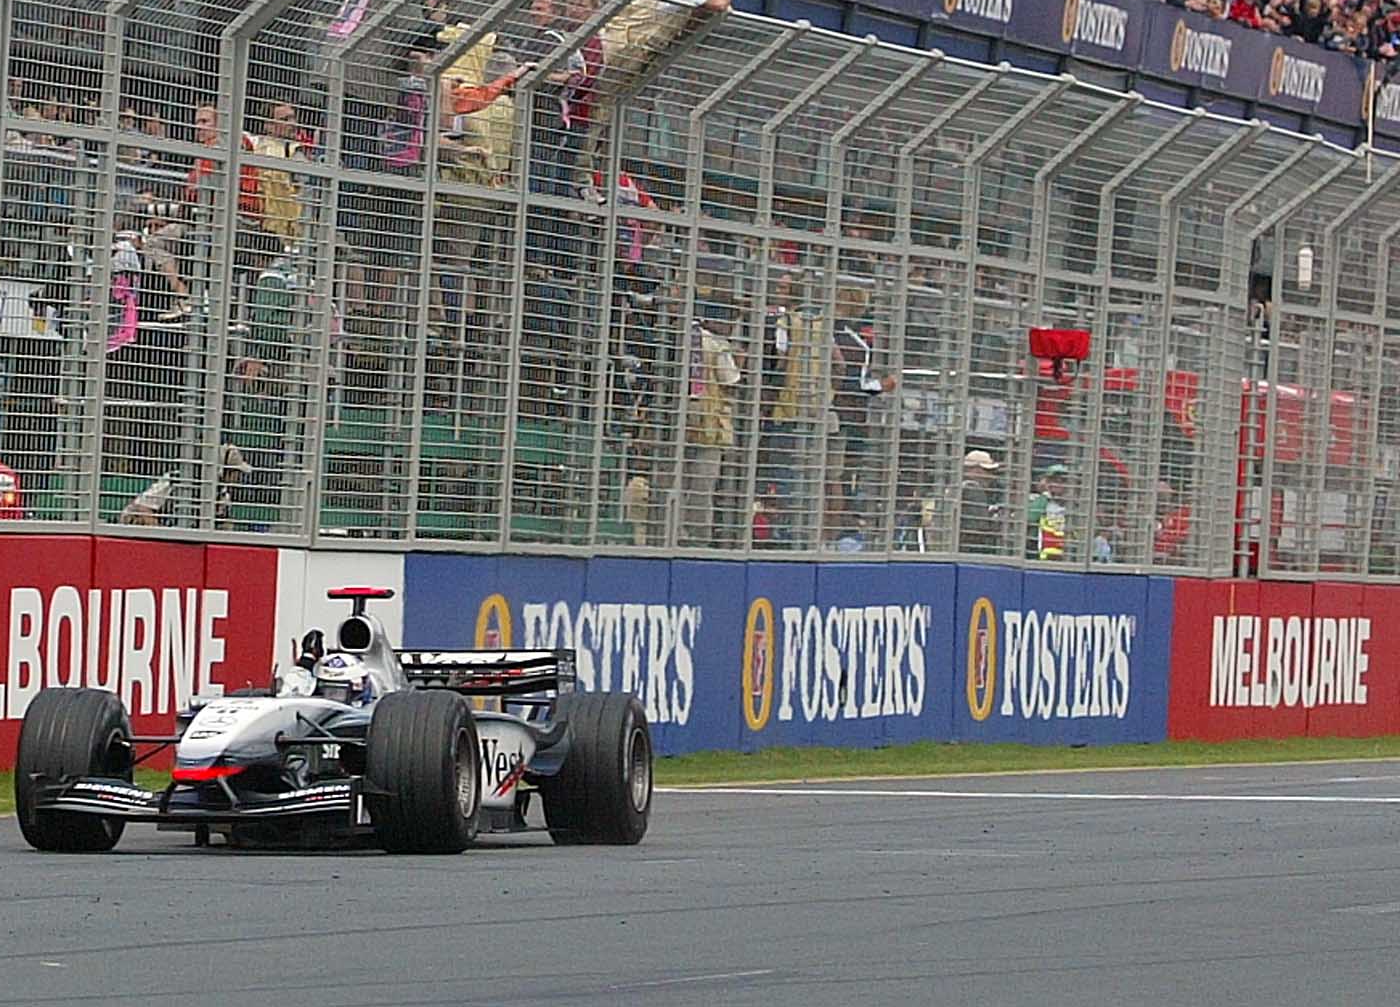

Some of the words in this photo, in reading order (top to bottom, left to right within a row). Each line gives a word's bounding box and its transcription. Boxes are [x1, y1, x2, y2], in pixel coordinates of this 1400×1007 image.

[778, 603, 927, 723] FOSTER'S
[1000, 610, 1133, 720] FOSTER'S
[1208, 613, 1372, 708] MELBOURNE
